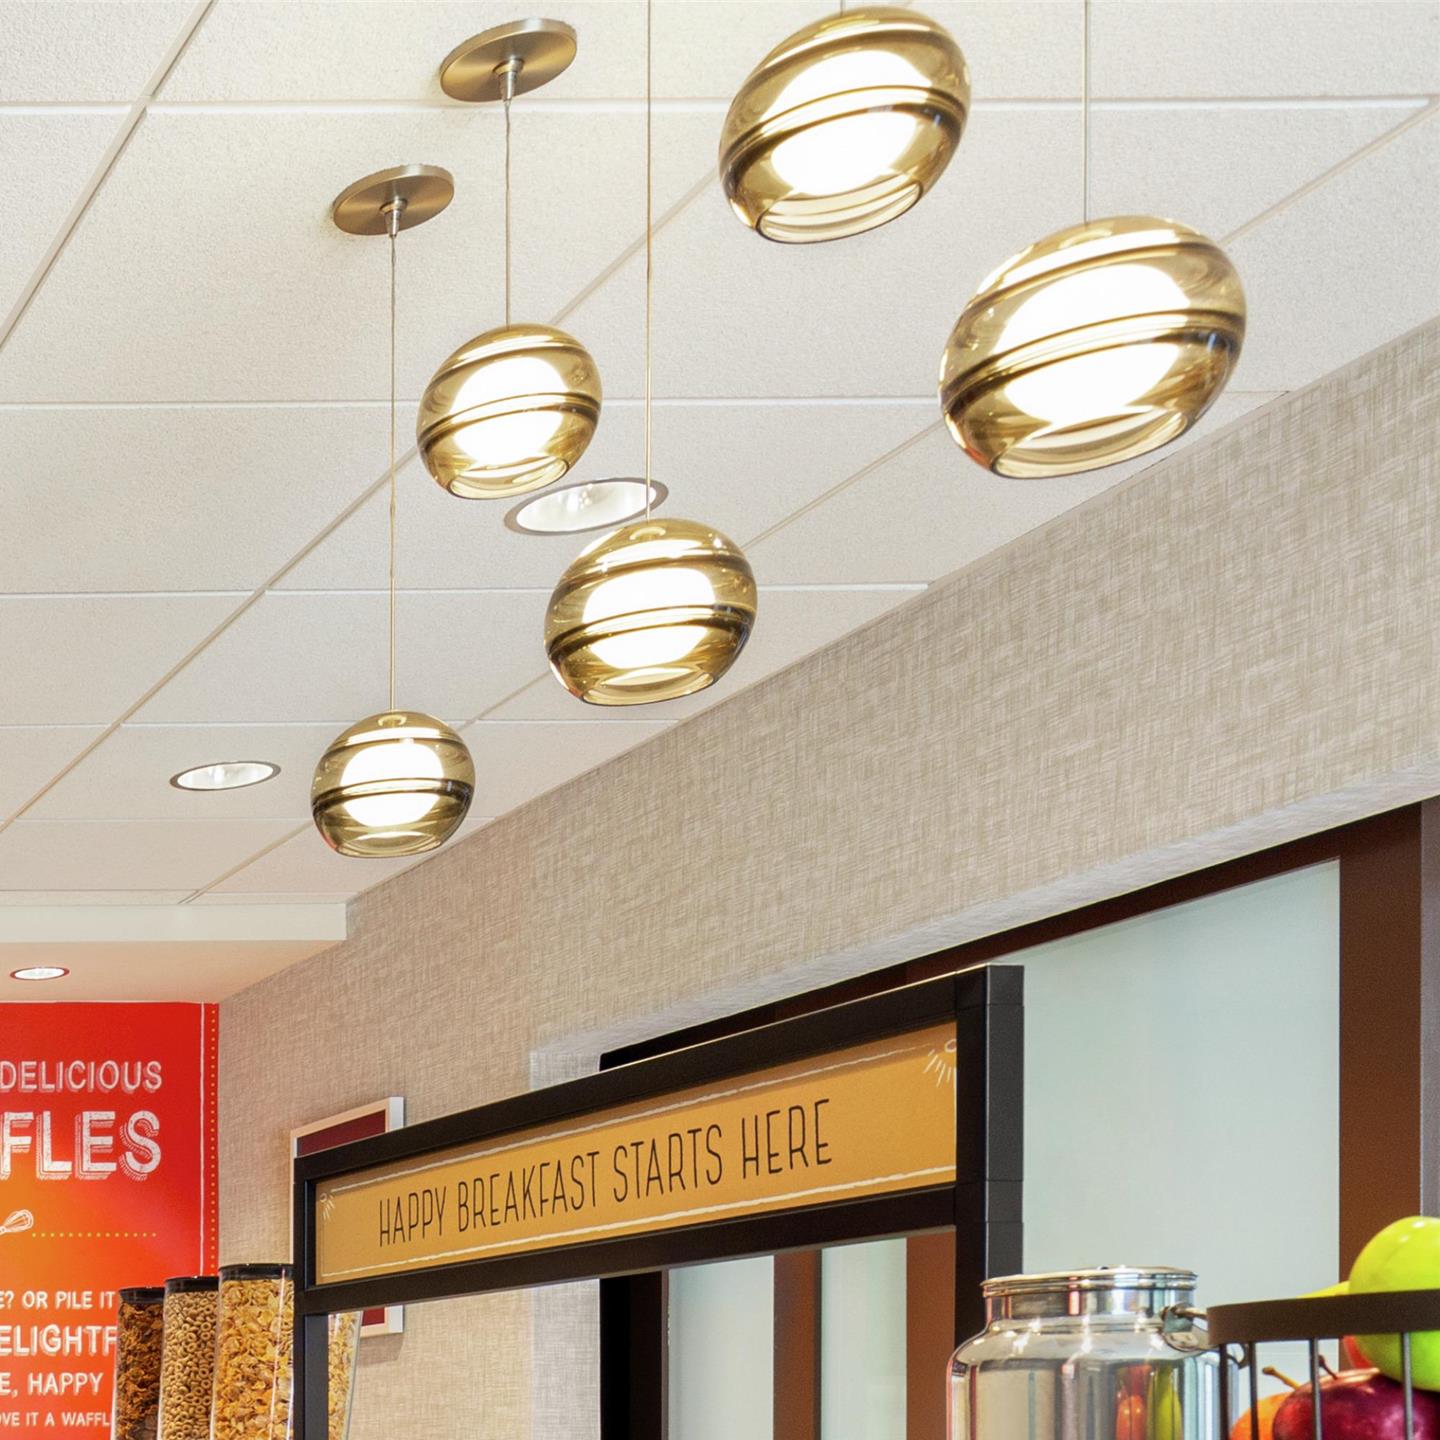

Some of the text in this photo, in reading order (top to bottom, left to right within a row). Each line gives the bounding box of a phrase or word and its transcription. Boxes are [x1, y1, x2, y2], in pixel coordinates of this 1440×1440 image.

[378, 1098, 833, 1248] HAPPY BREAKFAST STARTS HERE
[21, 1290, 48, 1311] OR
[55, 1290, 93, 1311] PILE
[99, 1290, 116, 1310] IT
[27, 1371, 104, 1397] HAPPY
[26, 1411, 39, 1427] IT
[44, 1411, 55, 1427] A
[61, 1411, 111, 1427] WAFFL
